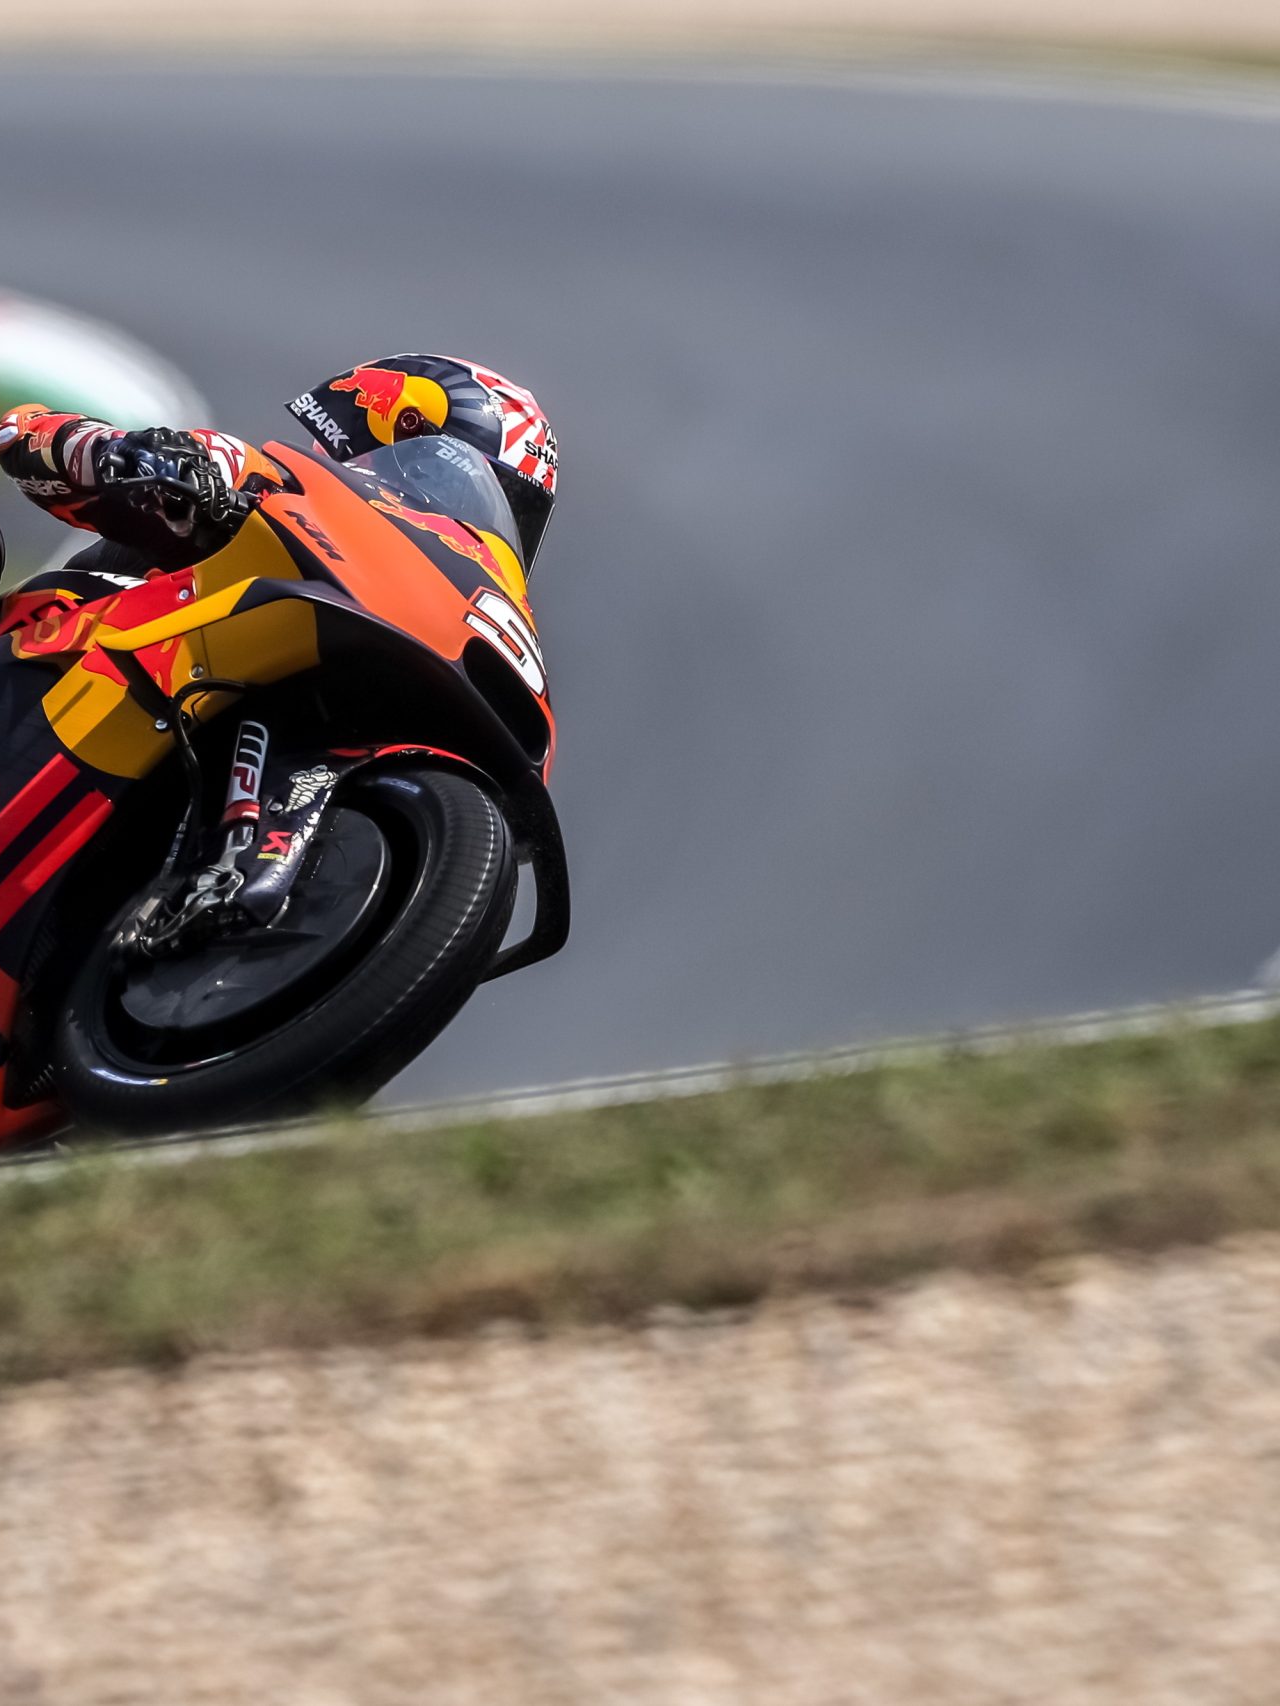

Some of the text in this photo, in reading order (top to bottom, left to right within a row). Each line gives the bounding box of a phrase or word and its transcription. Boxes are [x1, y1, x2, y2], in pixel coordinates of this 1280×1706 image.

[295, 393, 350, 449] SHARK
[283, 509, 346, 563] KTM
[464, 590, 548, 696] 5
